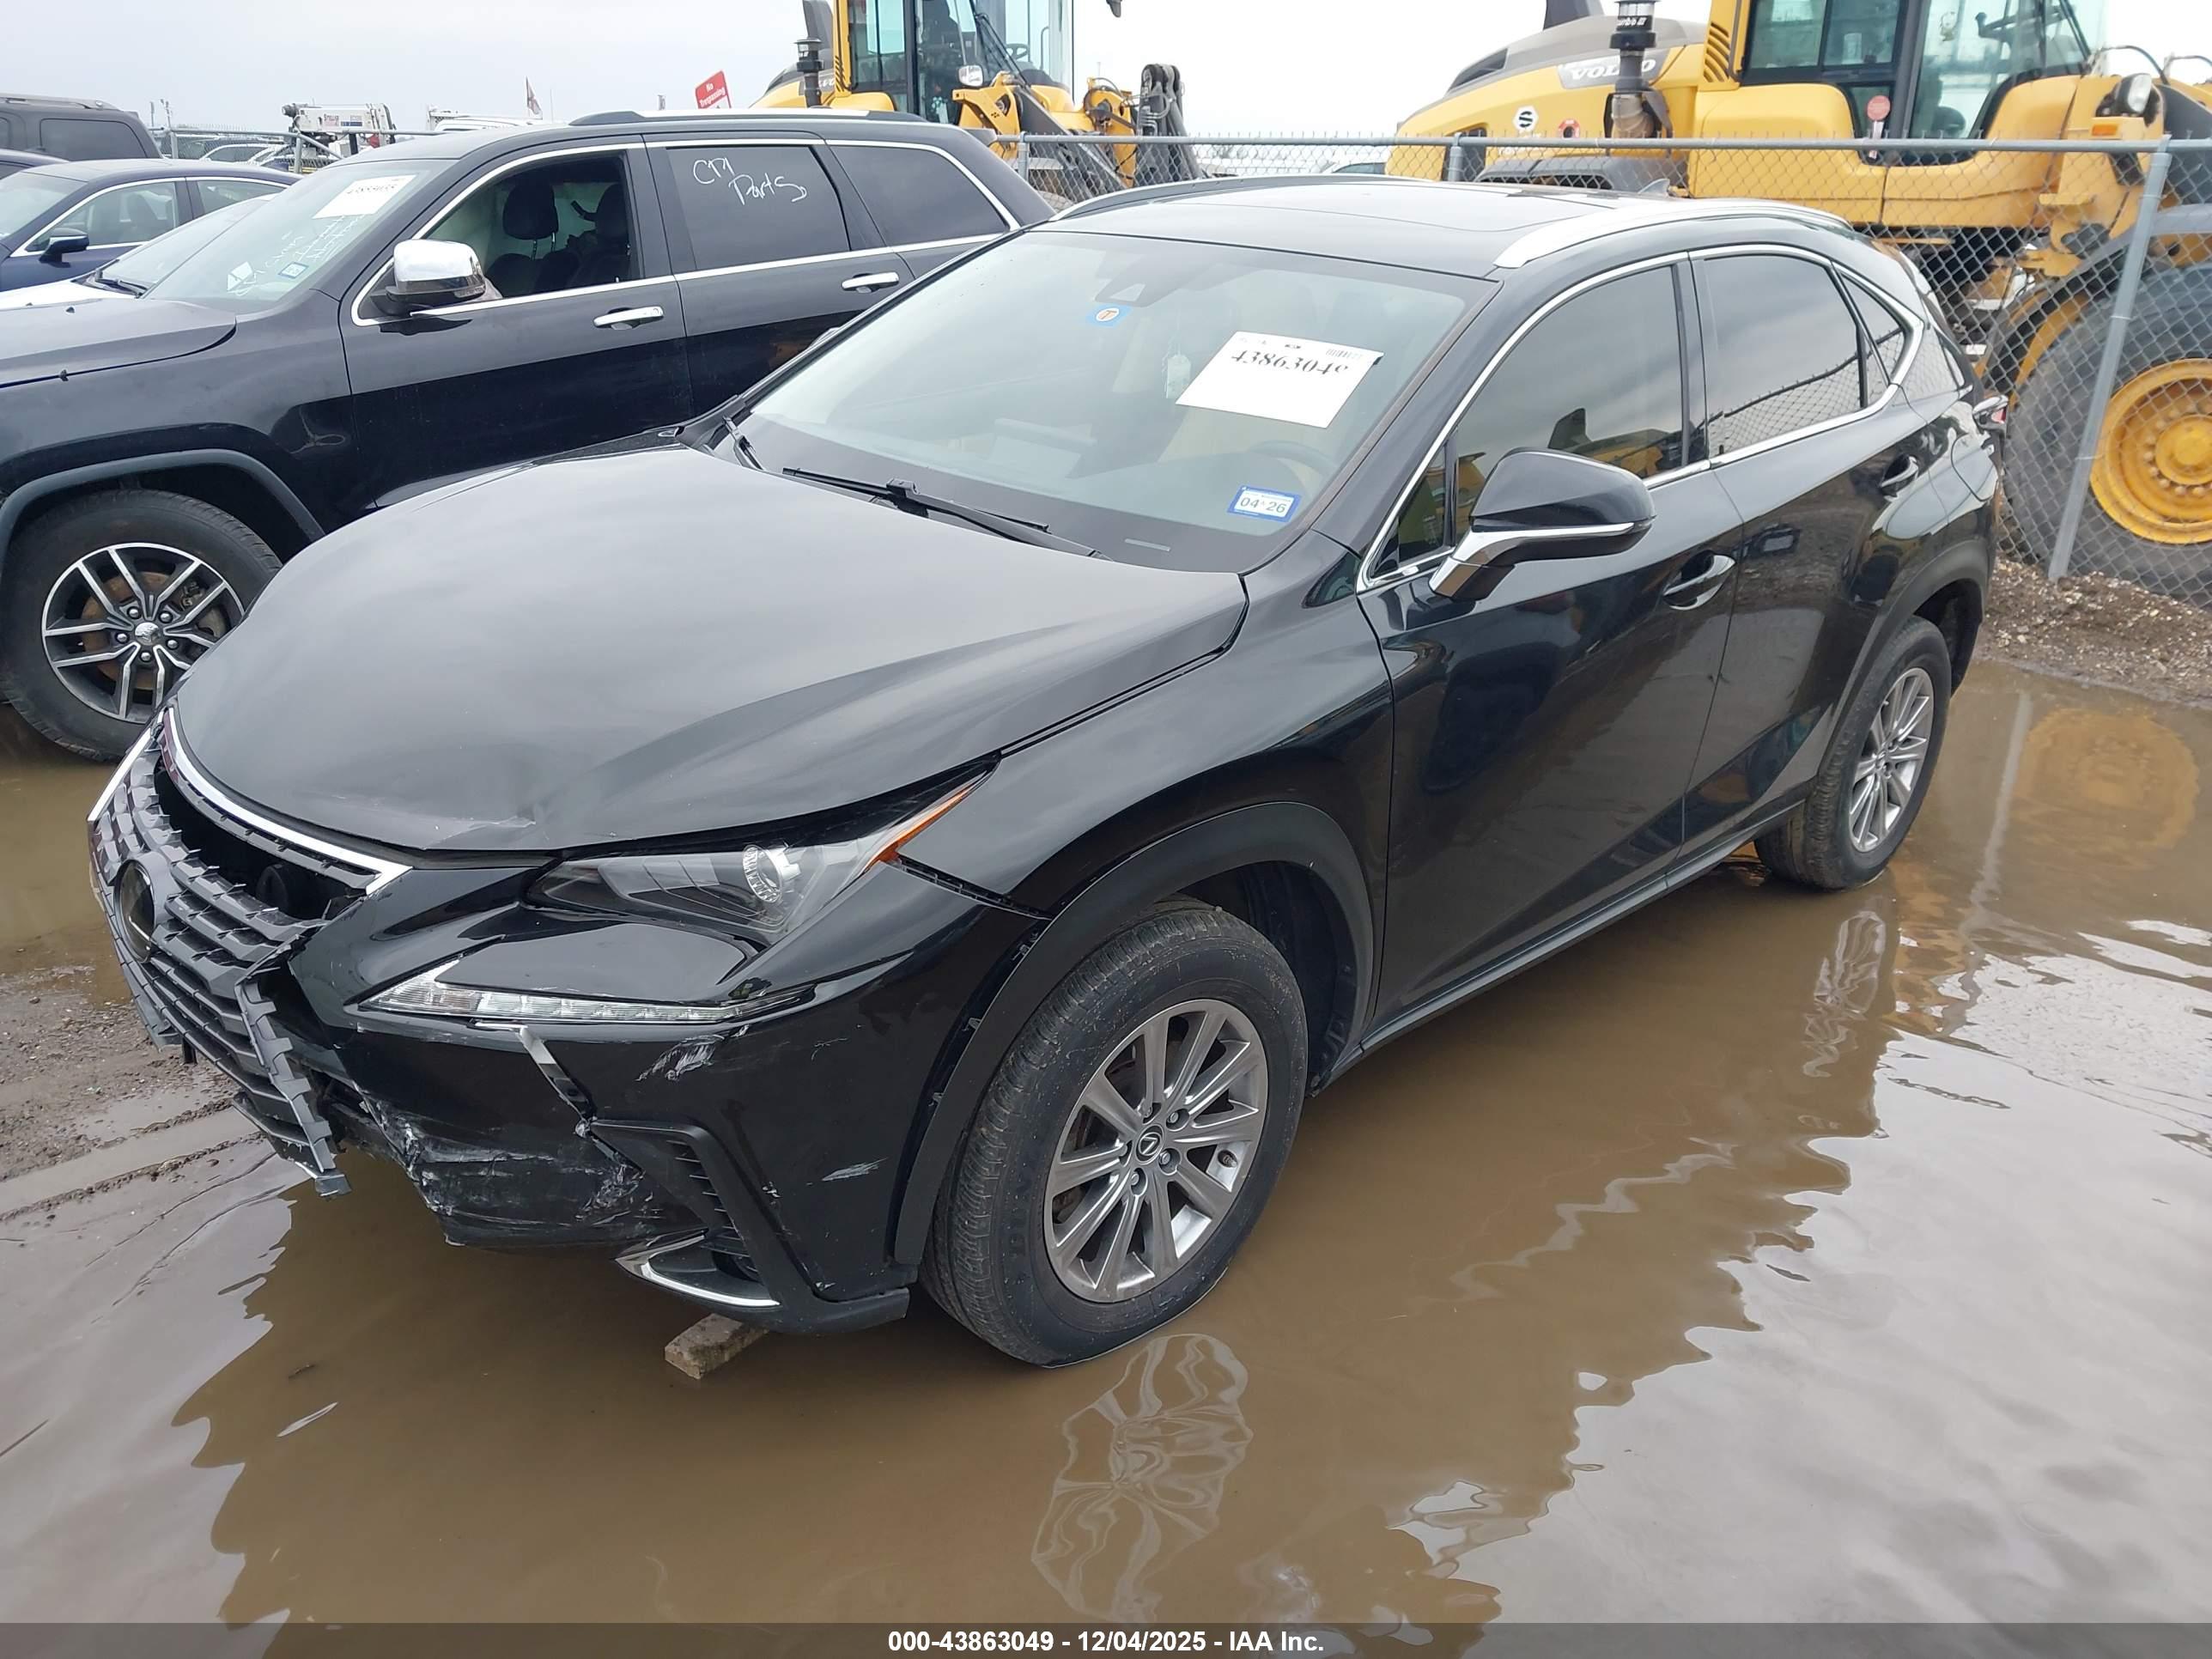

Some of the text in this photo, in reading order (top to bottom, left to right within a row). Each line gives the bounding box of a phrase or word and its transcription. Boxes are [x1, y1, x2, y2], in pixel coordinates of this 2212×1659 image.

[1571, 59, 1656, 80] VOLO
[705, 82, 714, 92] No
[699, 87, 726, 108] Trespassing
[1240, 497, 1287, 514] 04 26
